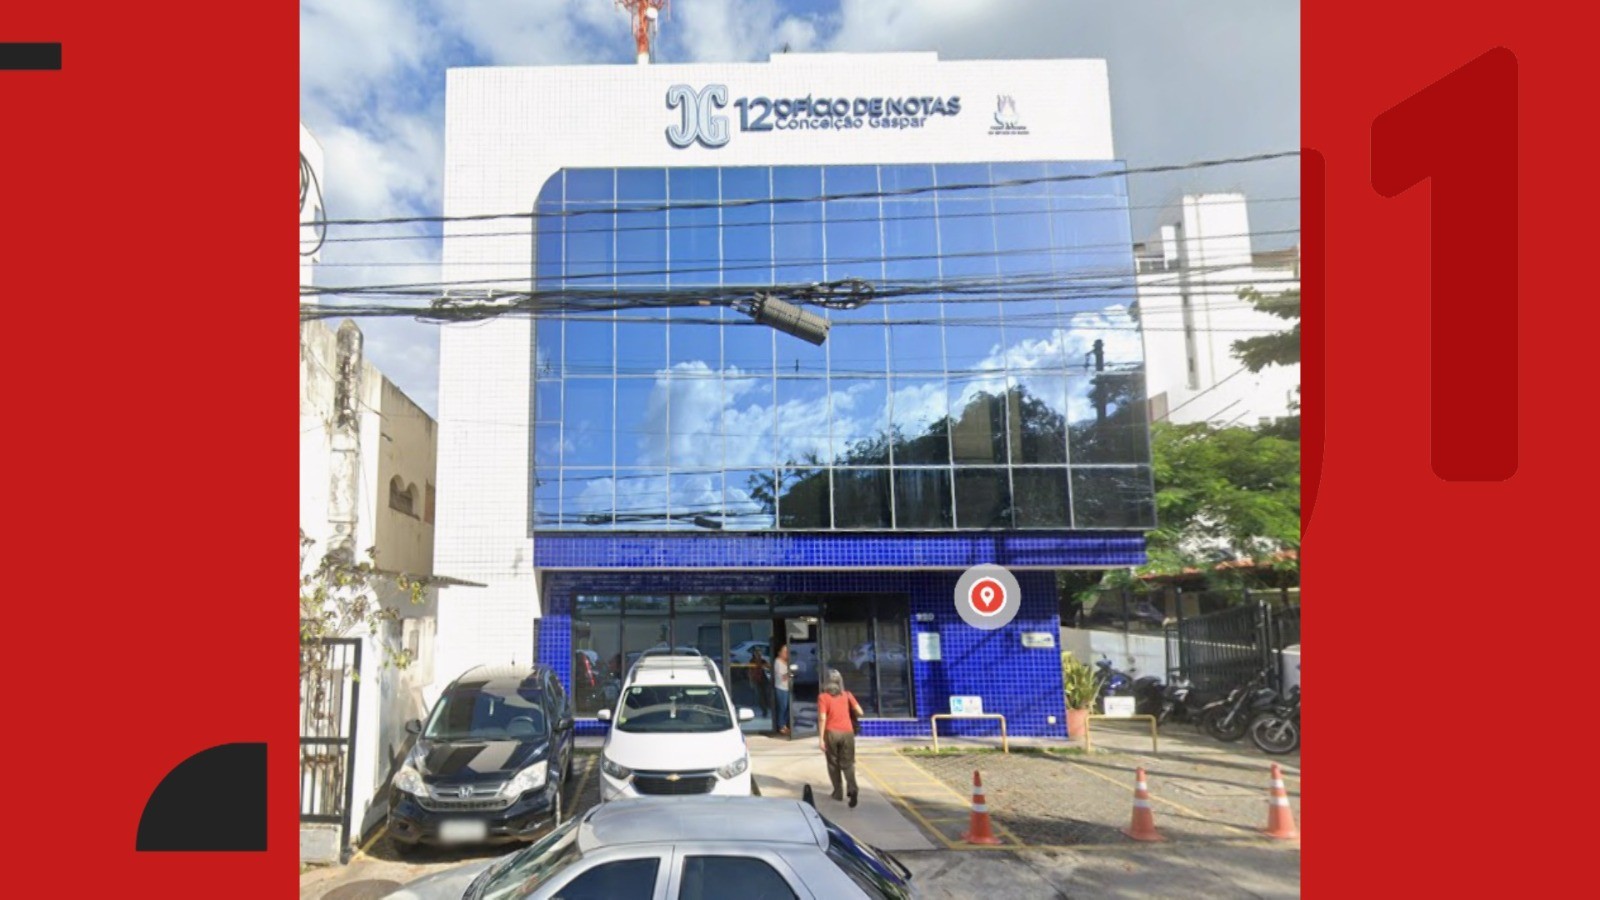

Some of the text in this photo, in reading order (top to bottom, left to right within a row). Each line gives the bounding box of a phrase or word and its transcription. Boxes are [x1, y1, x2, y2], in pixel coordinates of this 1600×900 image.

[853, 97, 883, 117] DE
[885, 97, 961, 116] NOTAS
[868, 117, 927, 129] Gaspar
